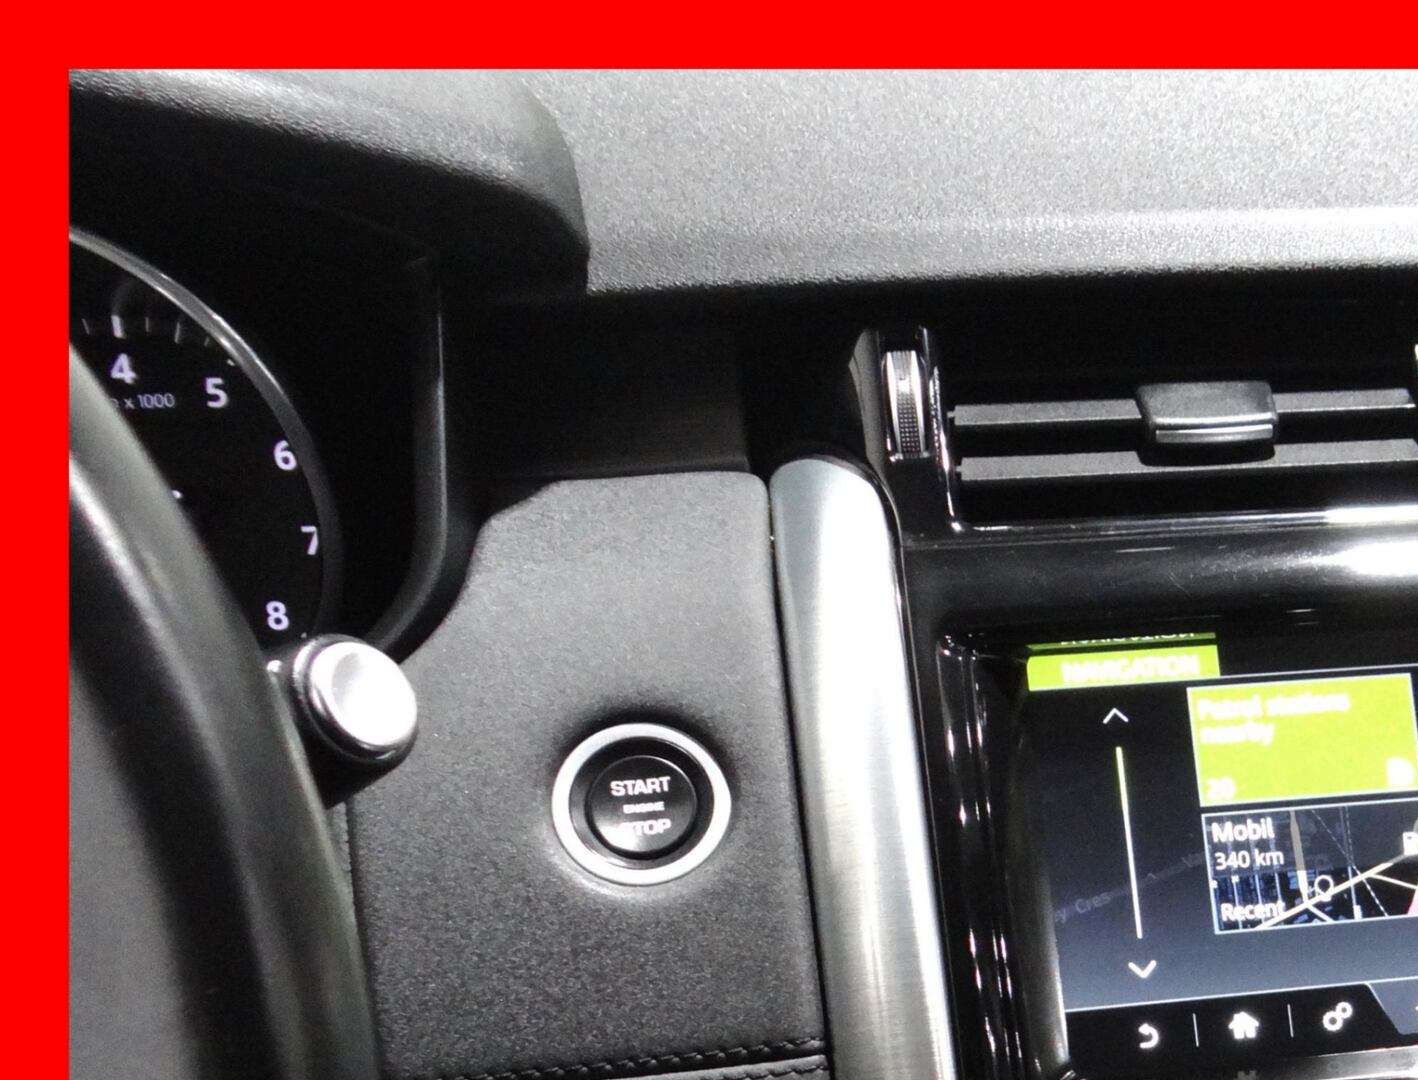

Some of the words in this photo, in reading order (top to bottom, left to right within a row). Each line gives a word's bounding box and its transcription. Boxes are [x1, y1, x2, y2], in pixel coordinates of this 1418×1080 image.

[110, 353, 136, 384] 4
[137, 392, 175, 409] 1000
[204, 377, 229, 408] 5
[273, 440, 297, 471] 6
[300, 525, 319, 556] 7
[265, 601, 289, 631] 8
[1061, 654, 1199, 684] NAVIGATION
[610, 776, 671, 797] START
[1211, 818, 1276, 843] Mobil
[1215, 850, 1249, 870] 340
[1255, 848, 1284, 868] km
[1220, 901, 1286, 922] Recent
